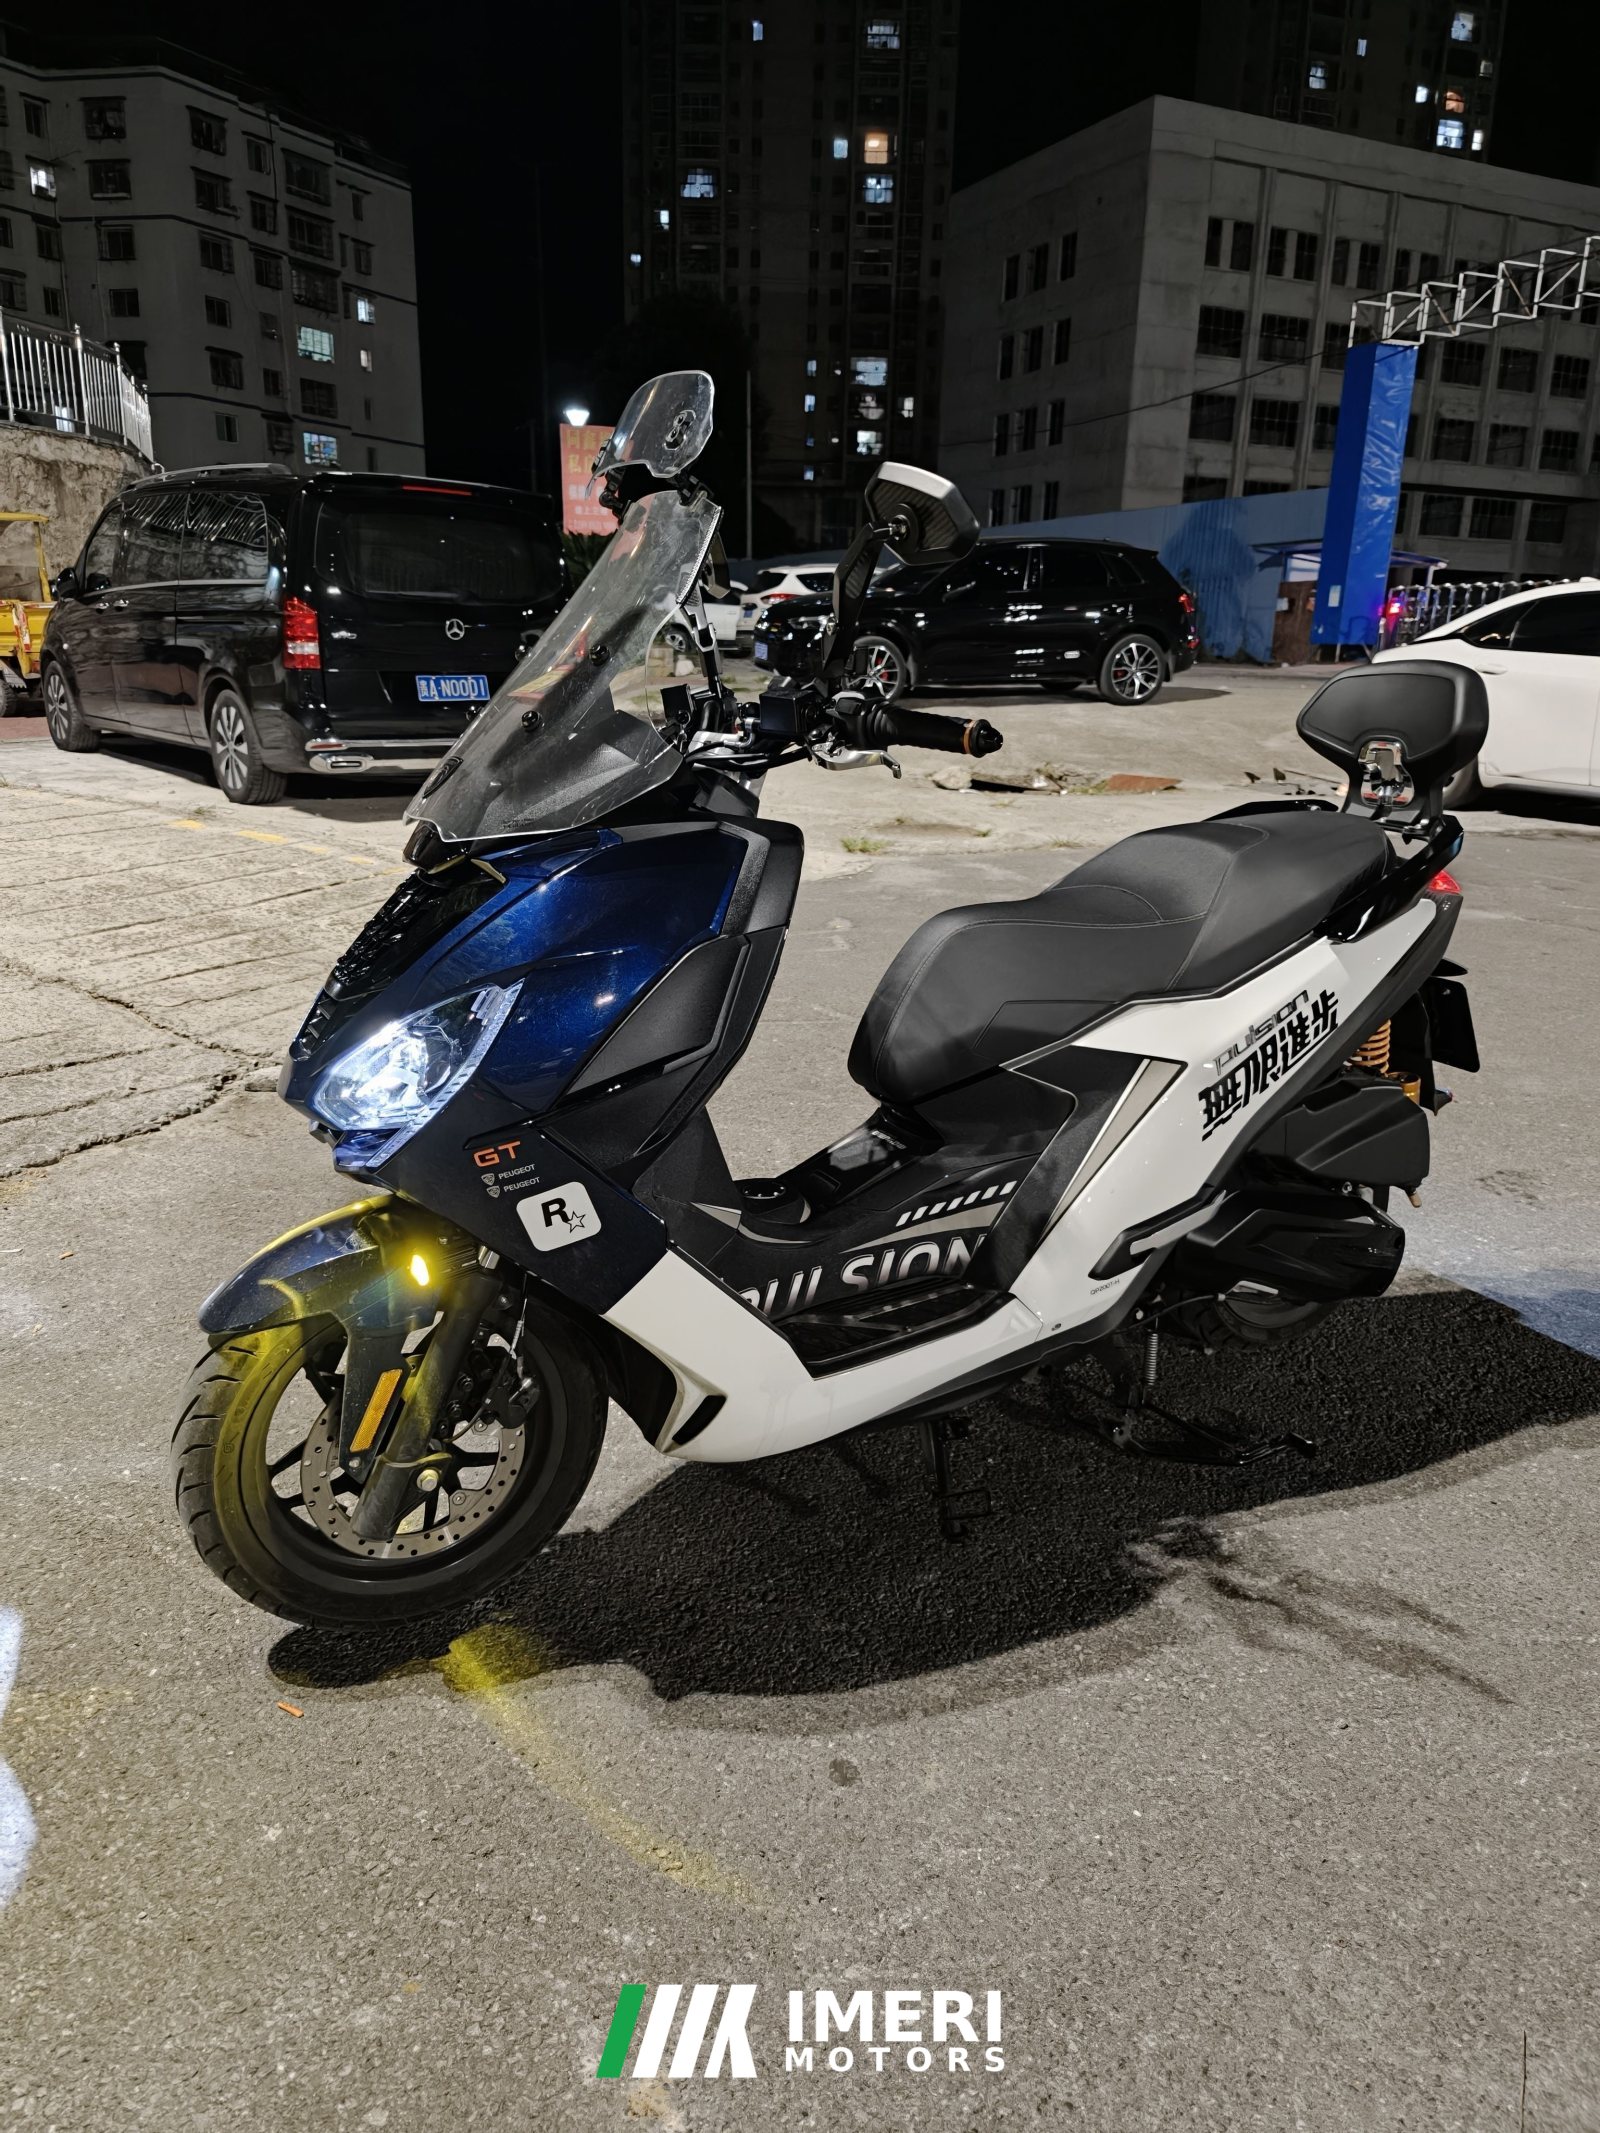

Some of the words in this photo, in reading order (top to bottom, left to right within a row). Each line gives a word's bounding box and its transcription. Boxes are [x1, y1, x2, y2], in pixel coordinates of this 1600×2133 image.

[473, 1140, 521, 1168] GT
[498, 1163, 536, 1180] PEUGEOT
[503, 1176, 541, 1193] PEUGEOT
[541, 1197, 571, 1228] R
